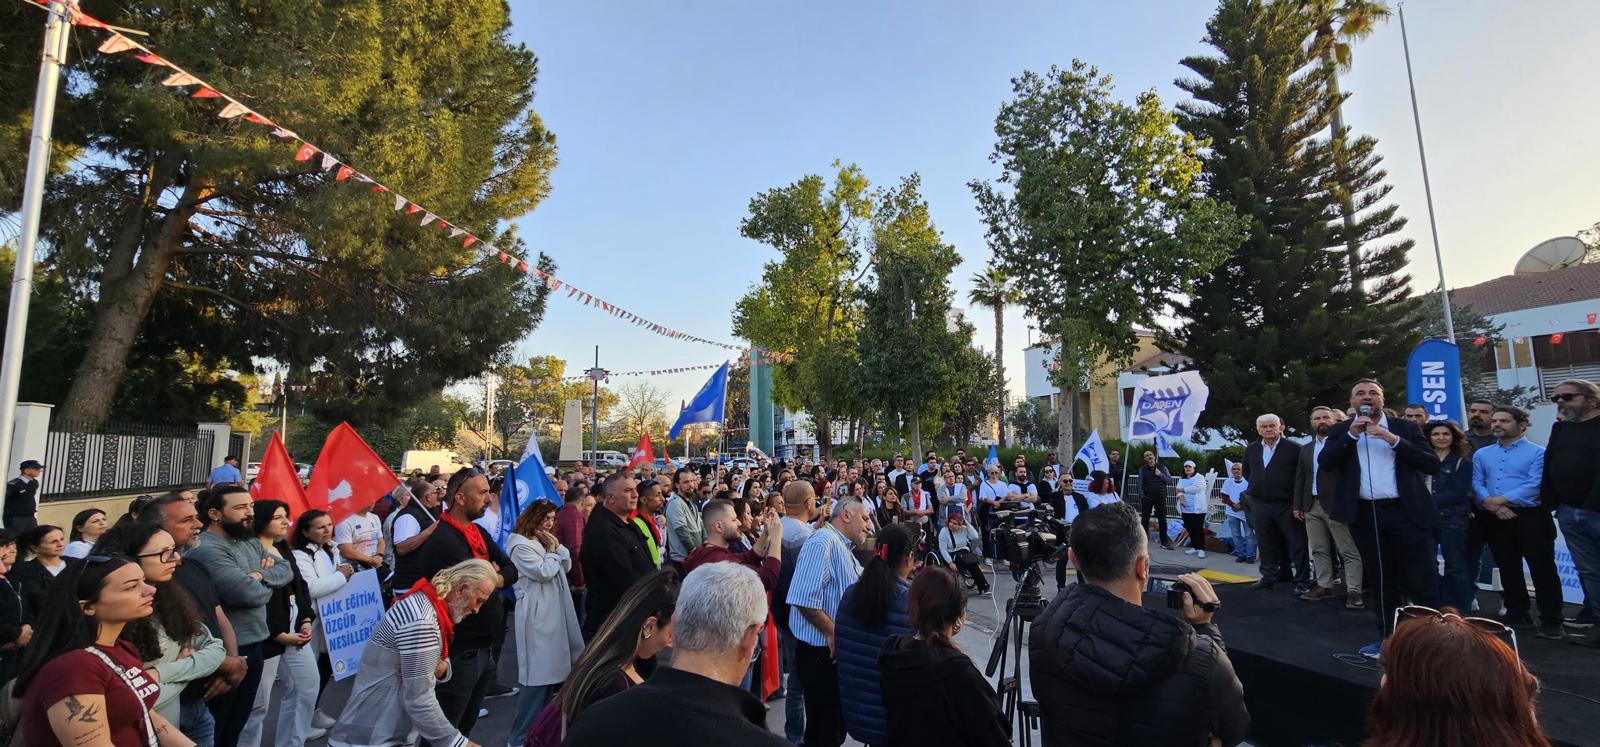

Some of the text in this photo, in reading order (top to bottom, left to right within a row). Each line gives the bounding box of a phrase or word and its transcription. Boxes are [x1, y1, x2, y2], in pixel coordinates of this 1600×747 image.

[321, 590, 379, 617] LAİK EĞİTİM,
[325, 613, 357, 634] ÖZGÜR
